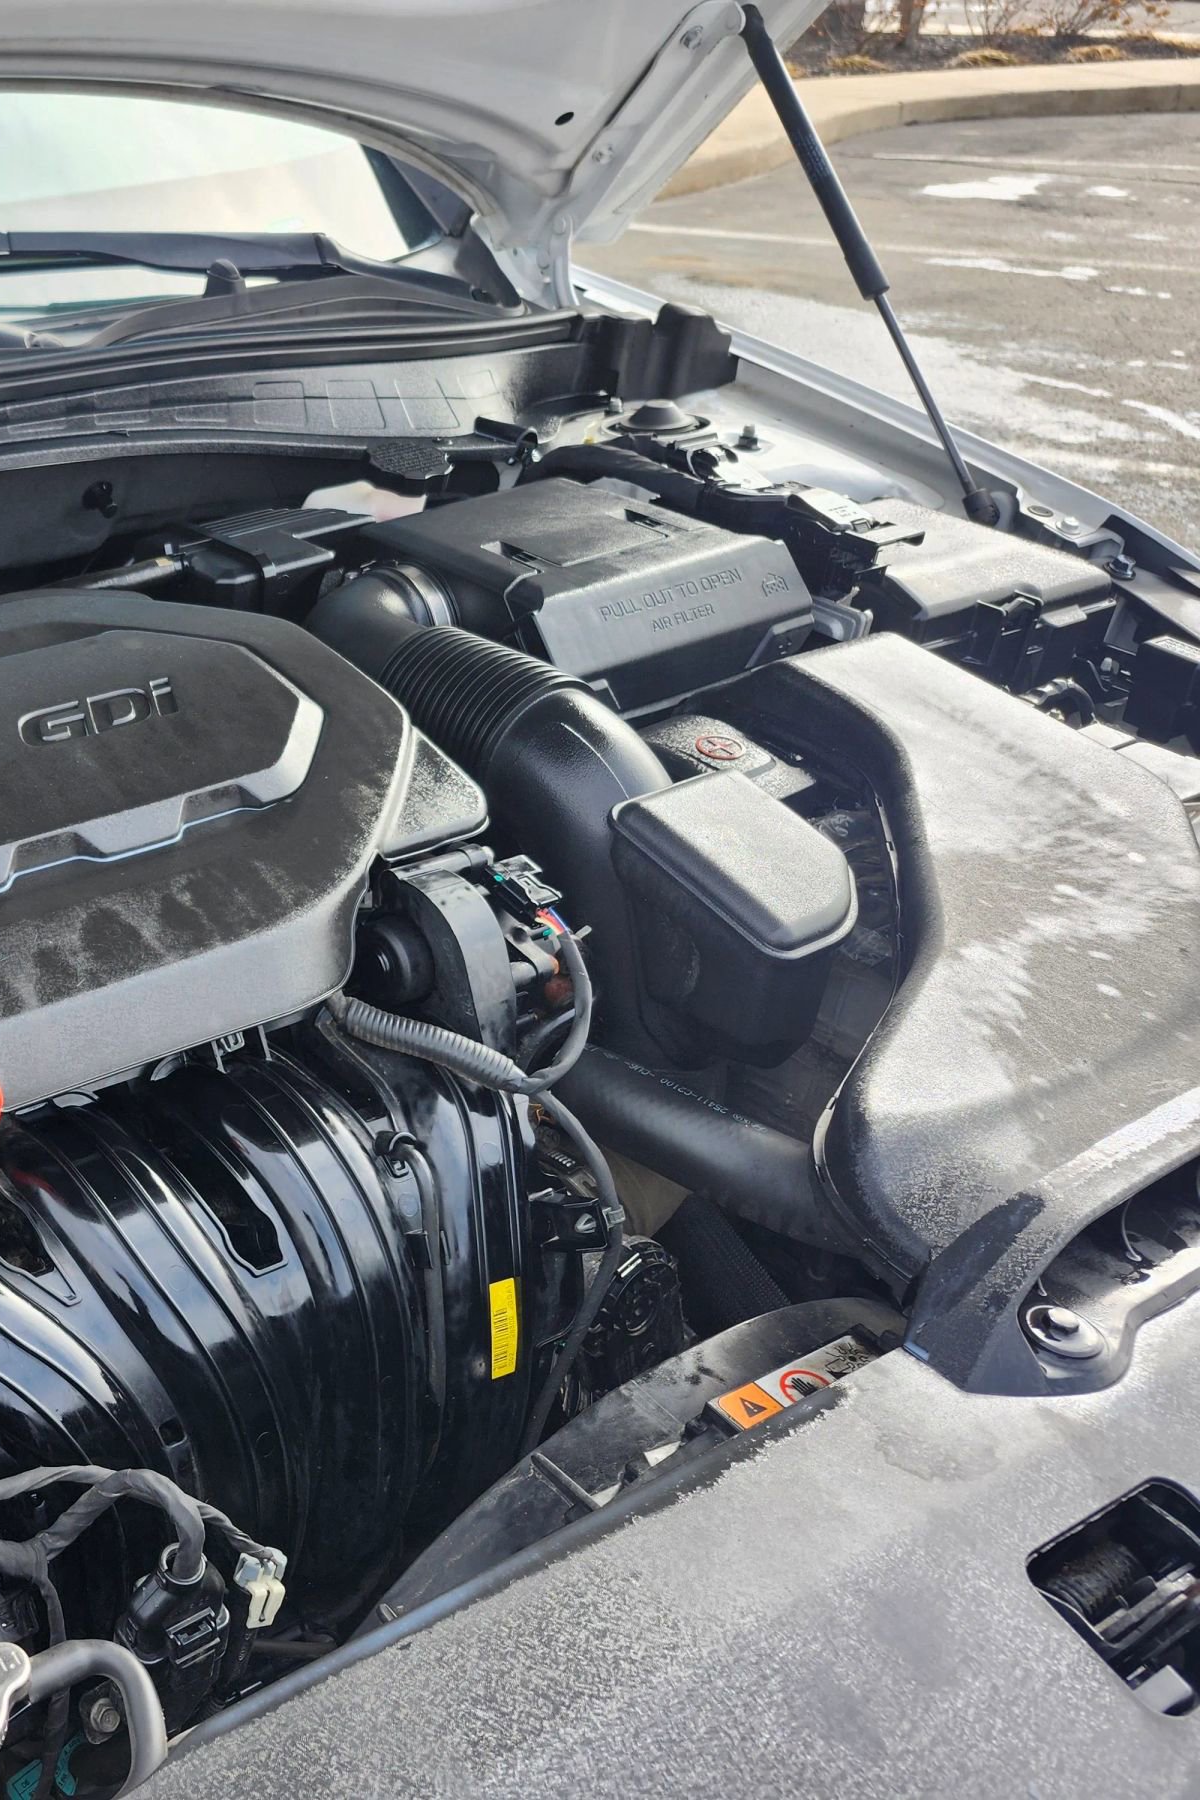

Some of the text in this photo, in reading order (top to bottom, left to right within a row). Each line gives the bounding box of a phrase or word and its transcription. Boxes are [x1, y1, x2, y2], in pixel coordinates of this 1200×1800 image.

[600, 567, 743, 622] PULL OUT TO OPEN
[651, 603, 716, 633] AIR FILTER
[17, 676, 178, 747] GDi
